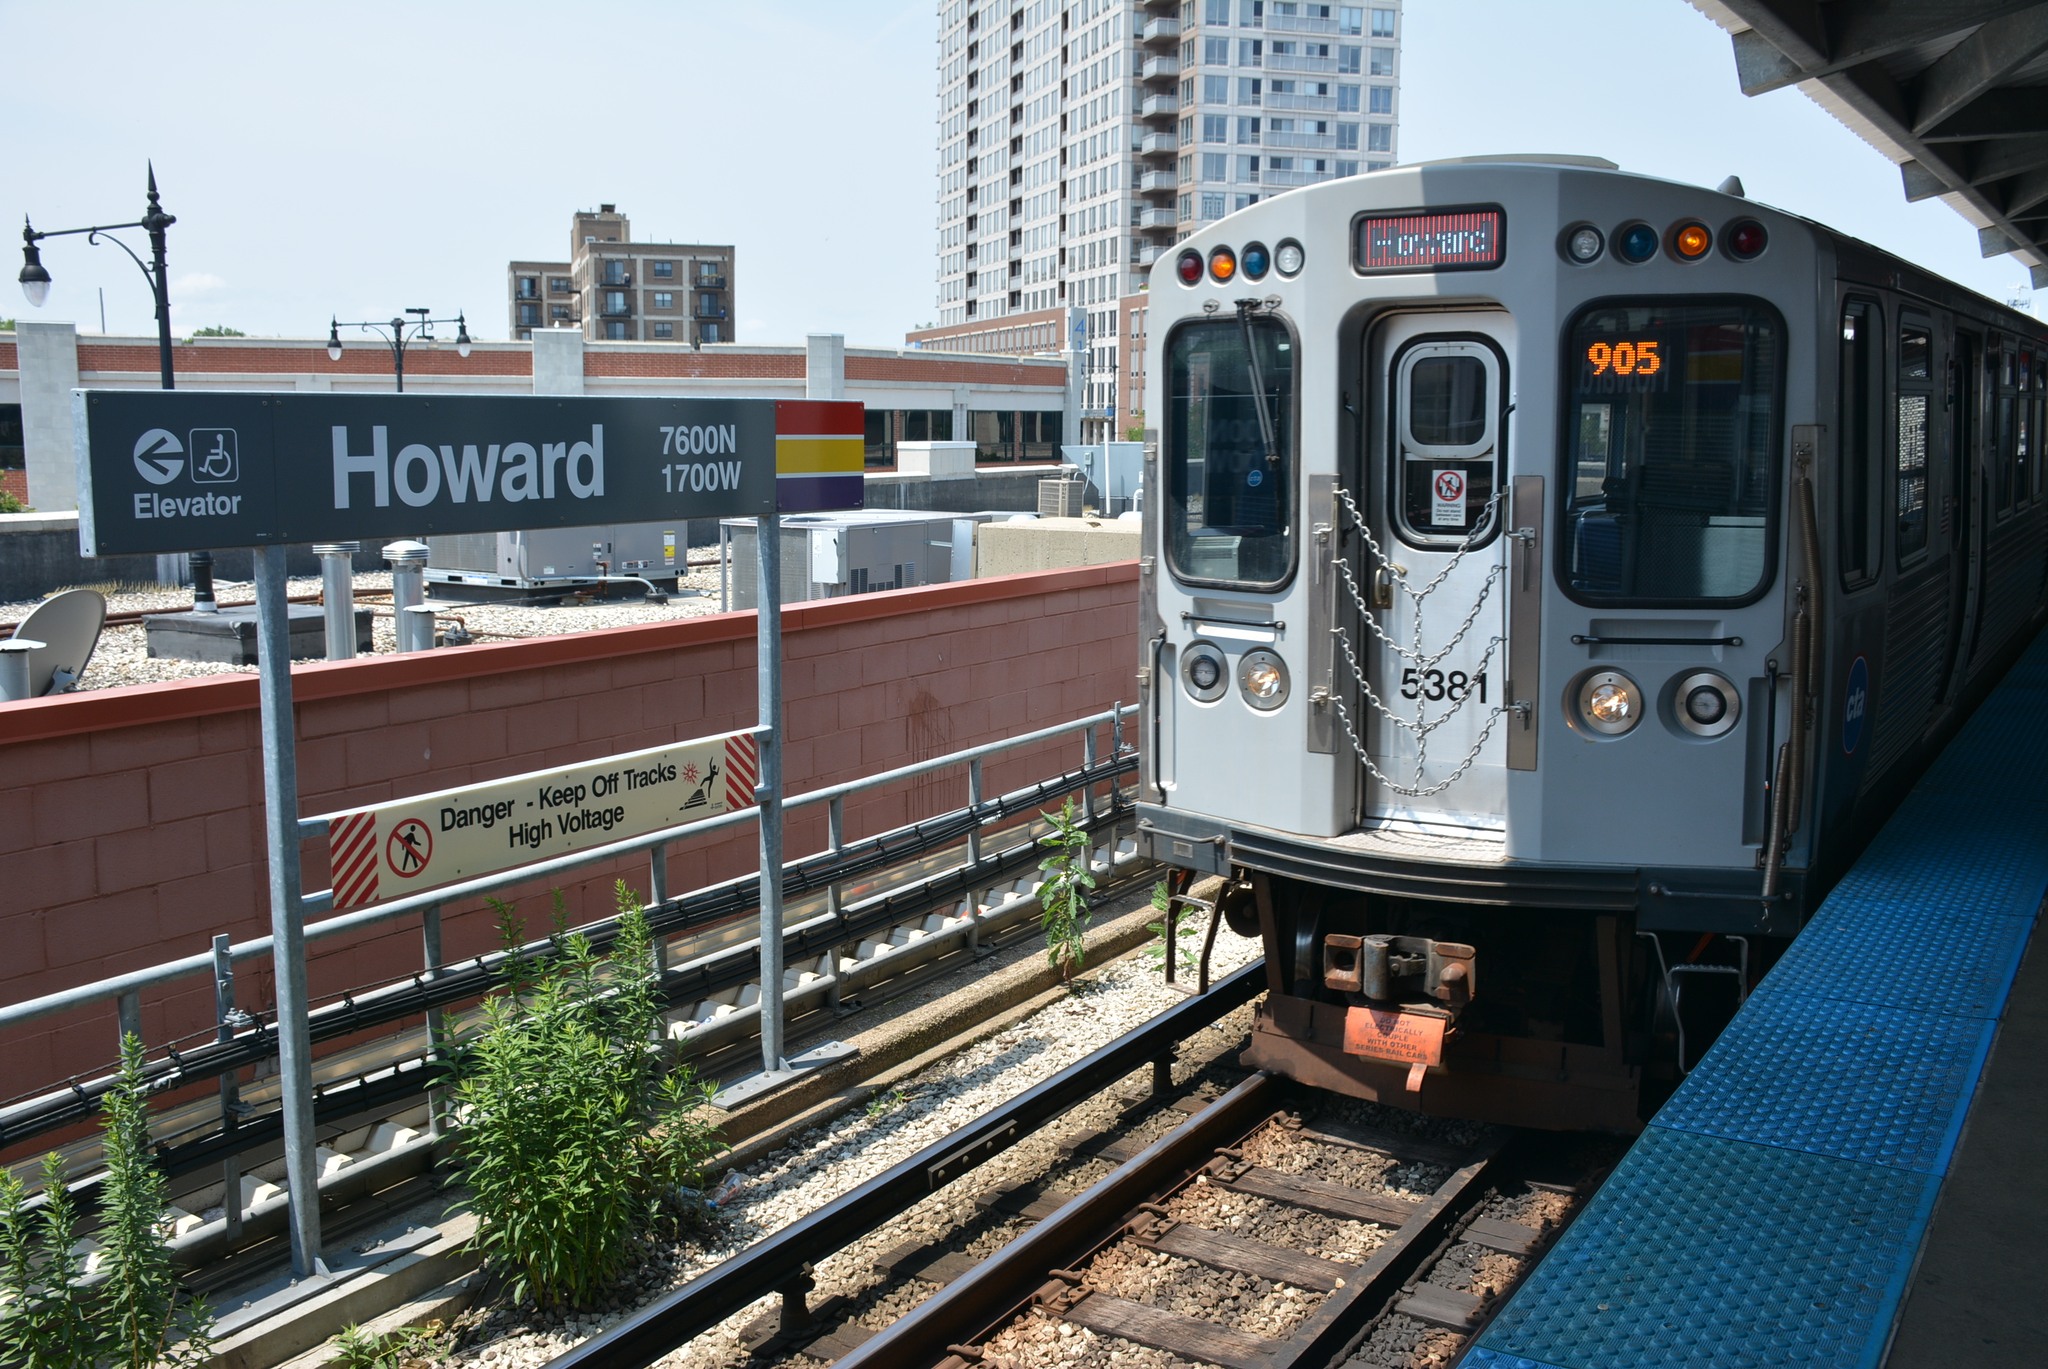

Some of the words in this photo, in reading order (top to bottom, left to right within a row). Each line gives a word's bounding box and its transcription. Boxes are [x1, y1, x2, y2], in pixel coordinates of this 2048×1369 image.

[1588, 341, 1660, 375] 905
[660, 423, 736, 456] 7600N
[331, 423, 605, 510] Howard
[661, 460, 742, 493] 1700W
[133, 492, 242, 519] Elevator
[1401, 668, 1487, 704] 5381
[1846, 686, 1865, 722] cta
[440, 797, 515, 832] Danger
[538, 784, 586, 811] Keep
[592, 772, 619, 797] Off
[623, 762, 677, 792] Tracks
[509, 815, 552, 850] High
[557, 805, 625, 837] Voltage
[1365, 1022, 1423, 1036] ELECTRICALLY
[1377, 1031, 1409, 1042] COUPLE
[1393, 1018, 1410, 1026] NOT
[1367, 1038, 1388, 1047] WITH
[1389, 1041, 1417, 1051] OTHER
[1406, 1050, 1428, 1061] CARS
